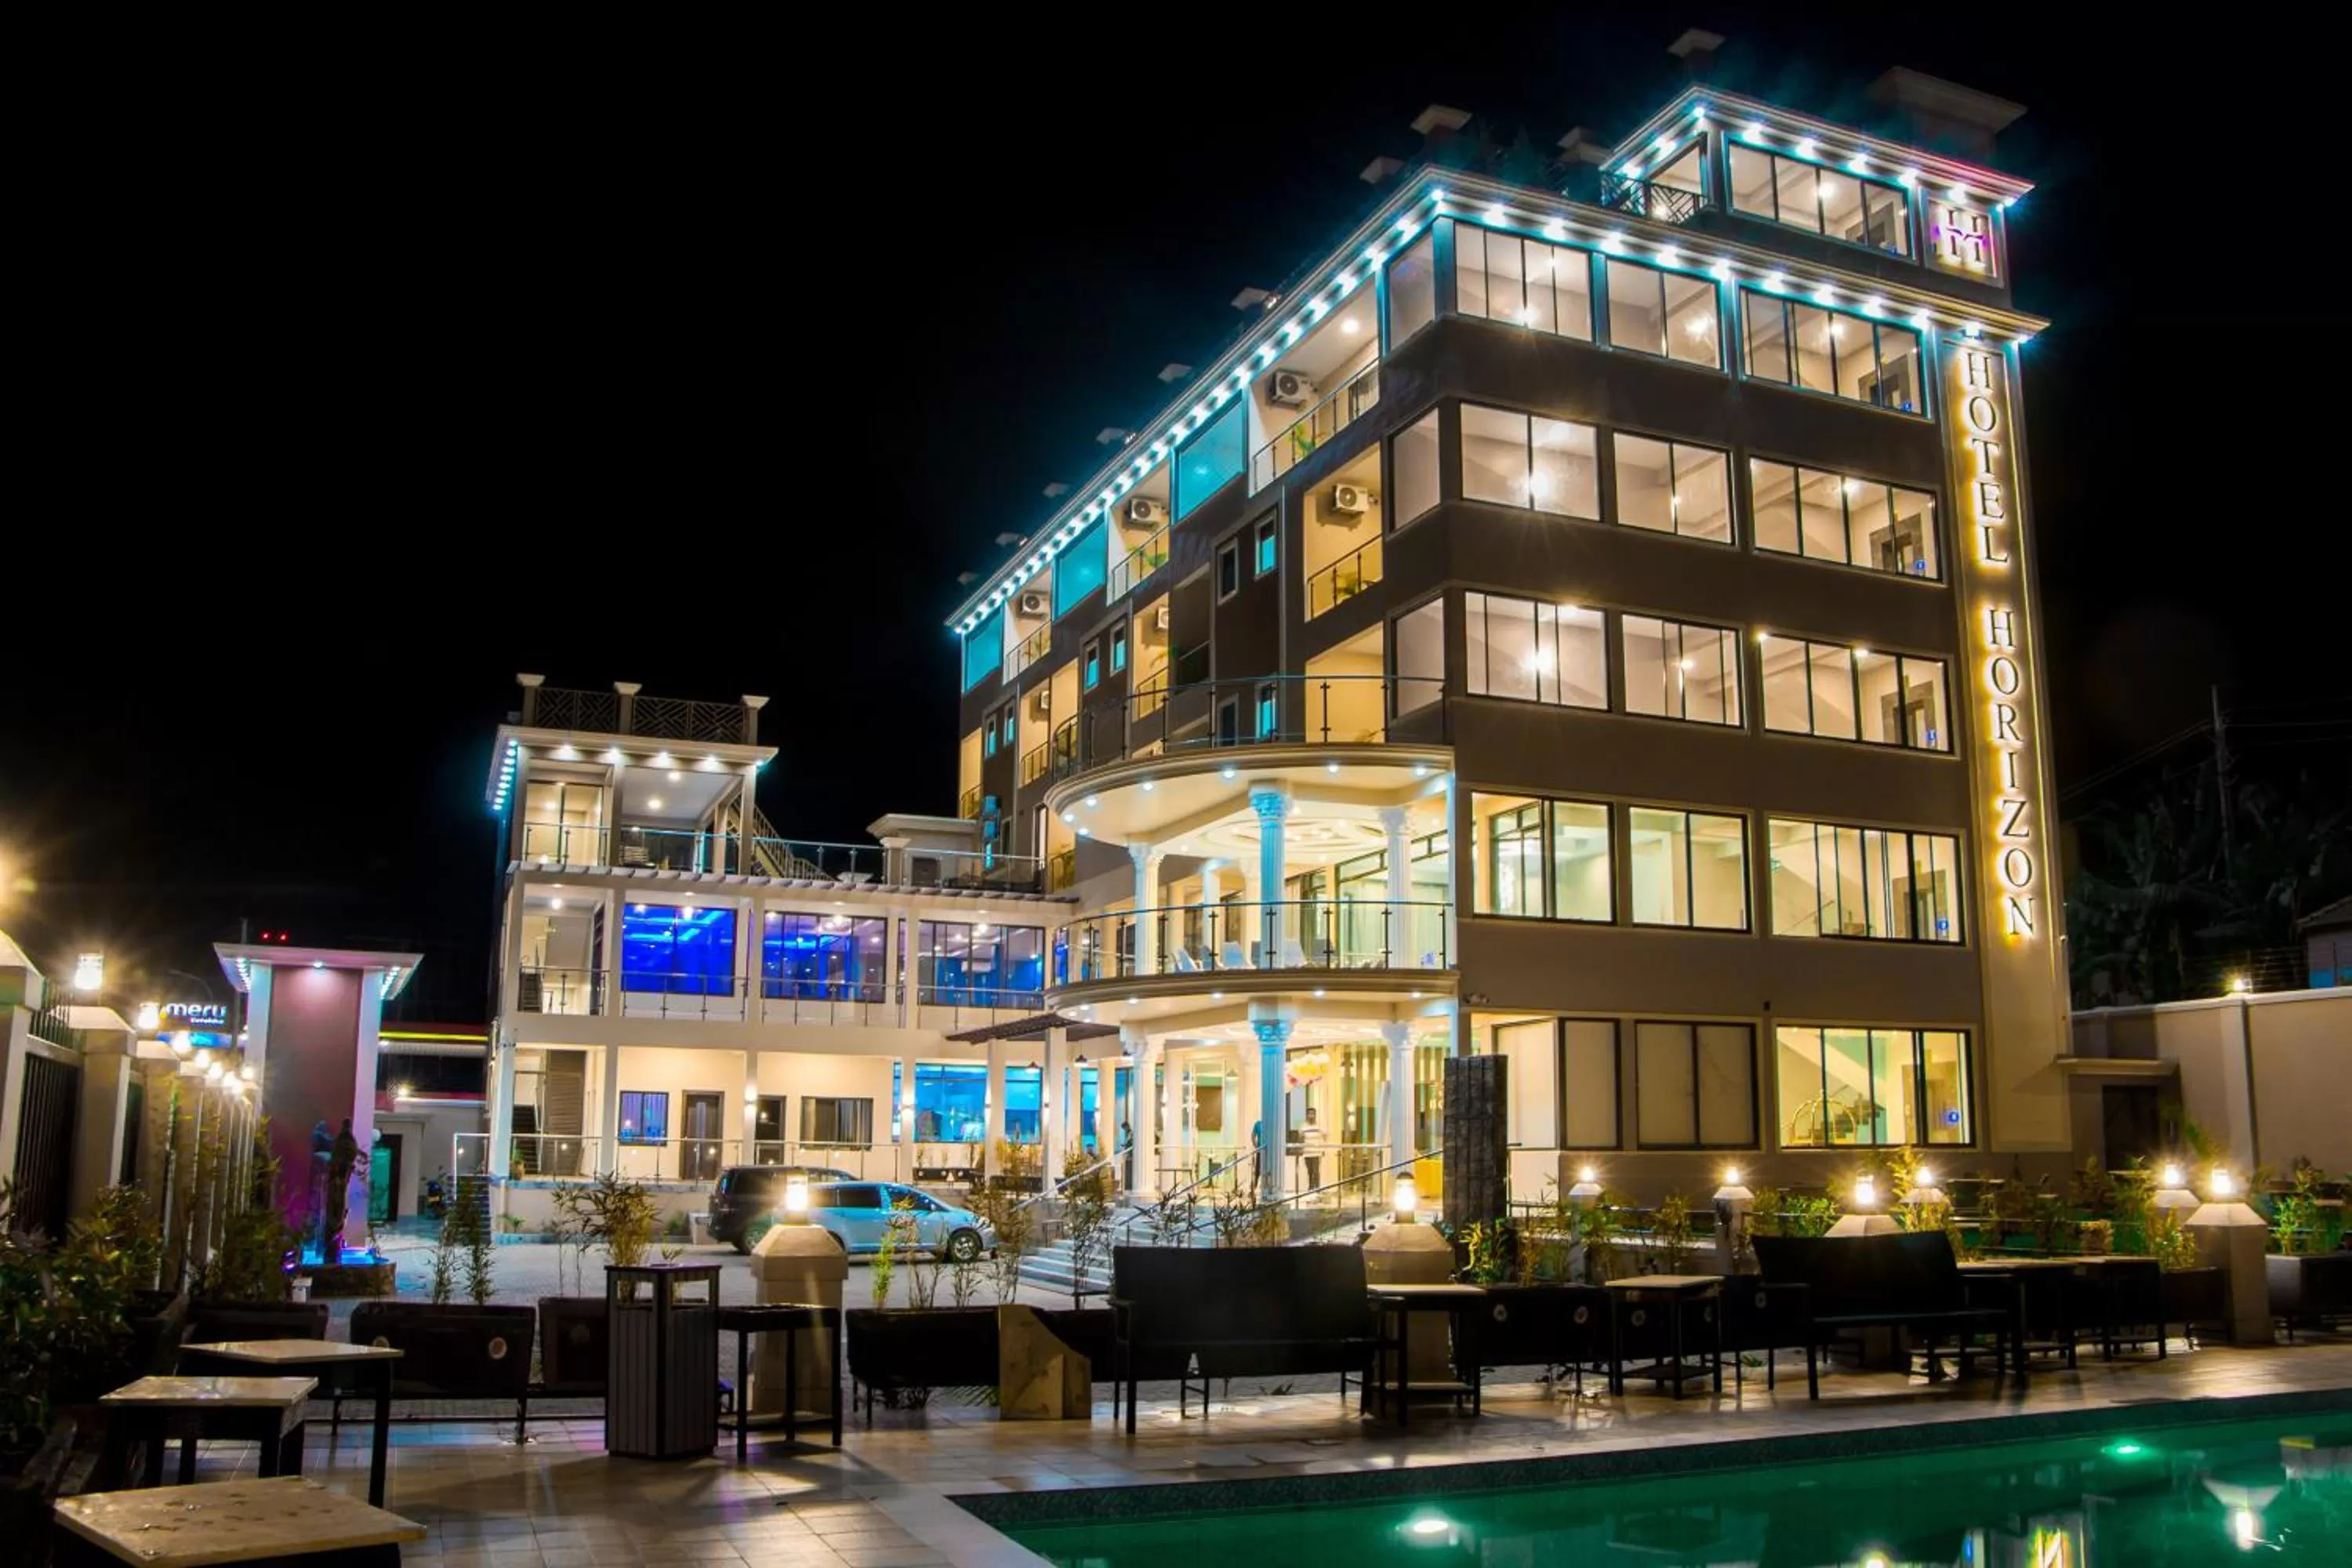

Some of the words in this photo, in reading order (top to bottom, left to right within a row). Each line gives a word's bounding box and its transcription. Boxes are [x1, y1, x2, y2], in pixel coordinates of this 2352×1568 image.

[1968, 352, 2009, 563] HOTEL
[1989, 608, 2036, 936] HORIZON
[166, 1003, 227, 1017] meru
